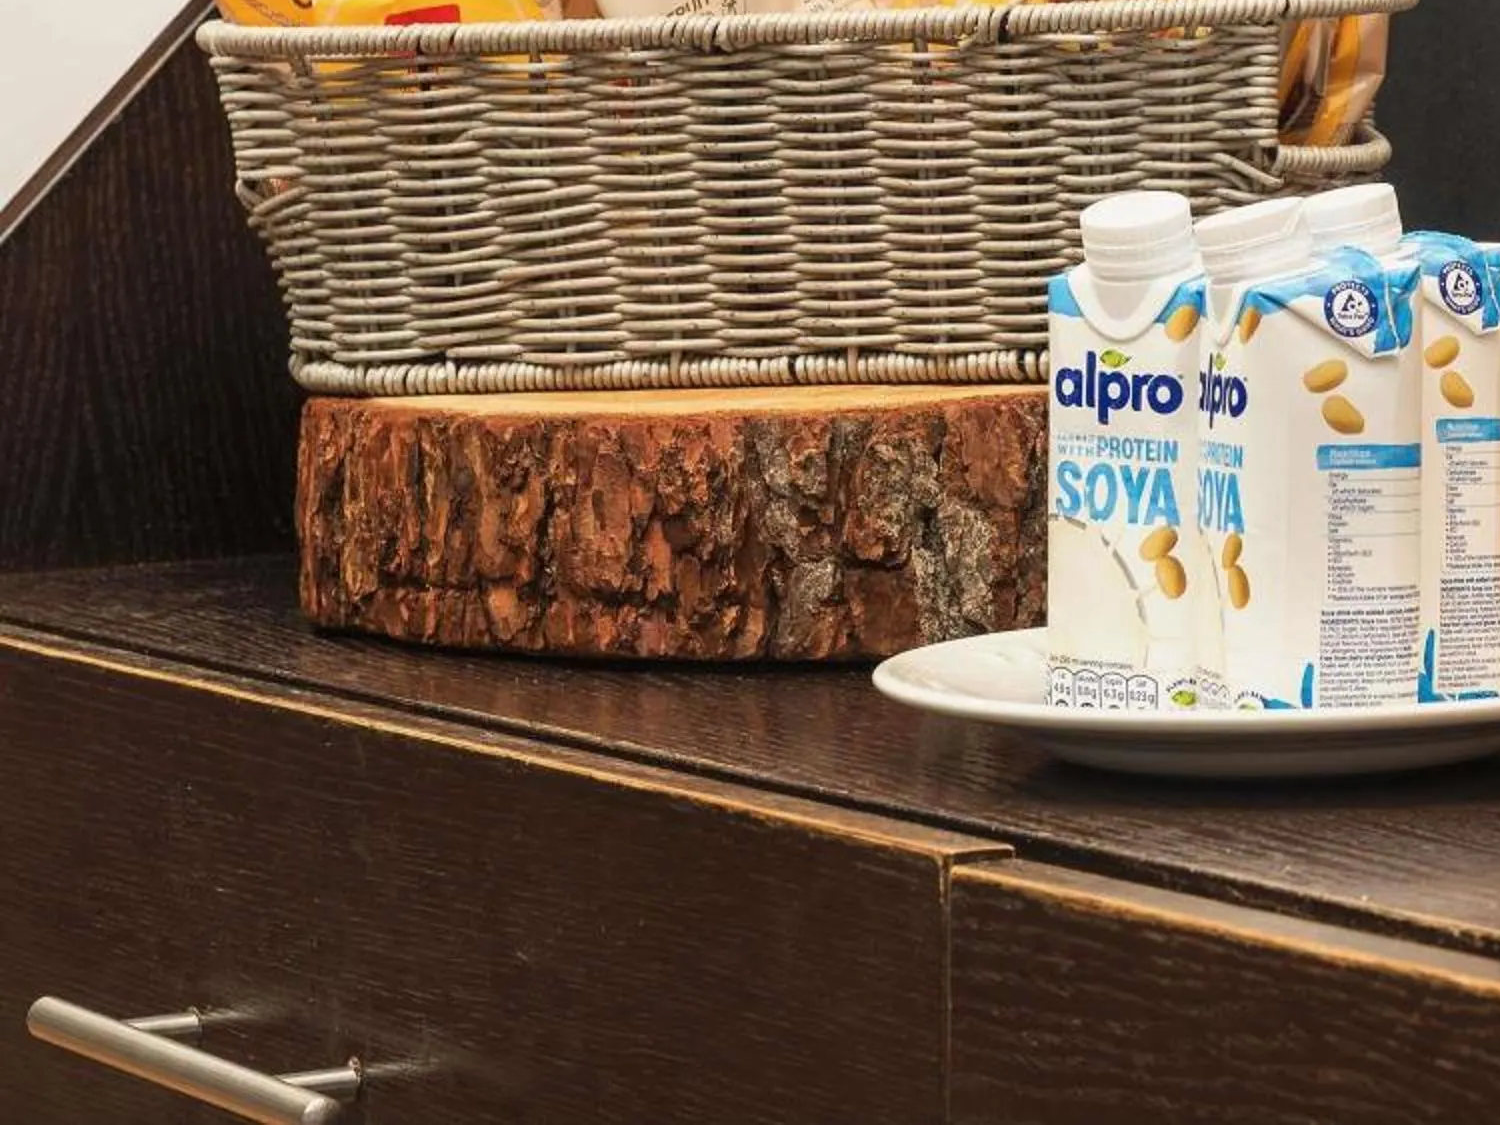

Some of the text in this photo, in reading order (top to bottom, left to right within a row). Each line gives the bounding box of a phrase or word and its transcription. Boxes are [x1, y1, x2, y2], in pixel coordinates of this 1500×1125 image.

[1055, 350, 1184, 425] alpro
[1097, 435, 1179, 463] PROTEIN
[1055, 459, 1181, 527] SOYA
